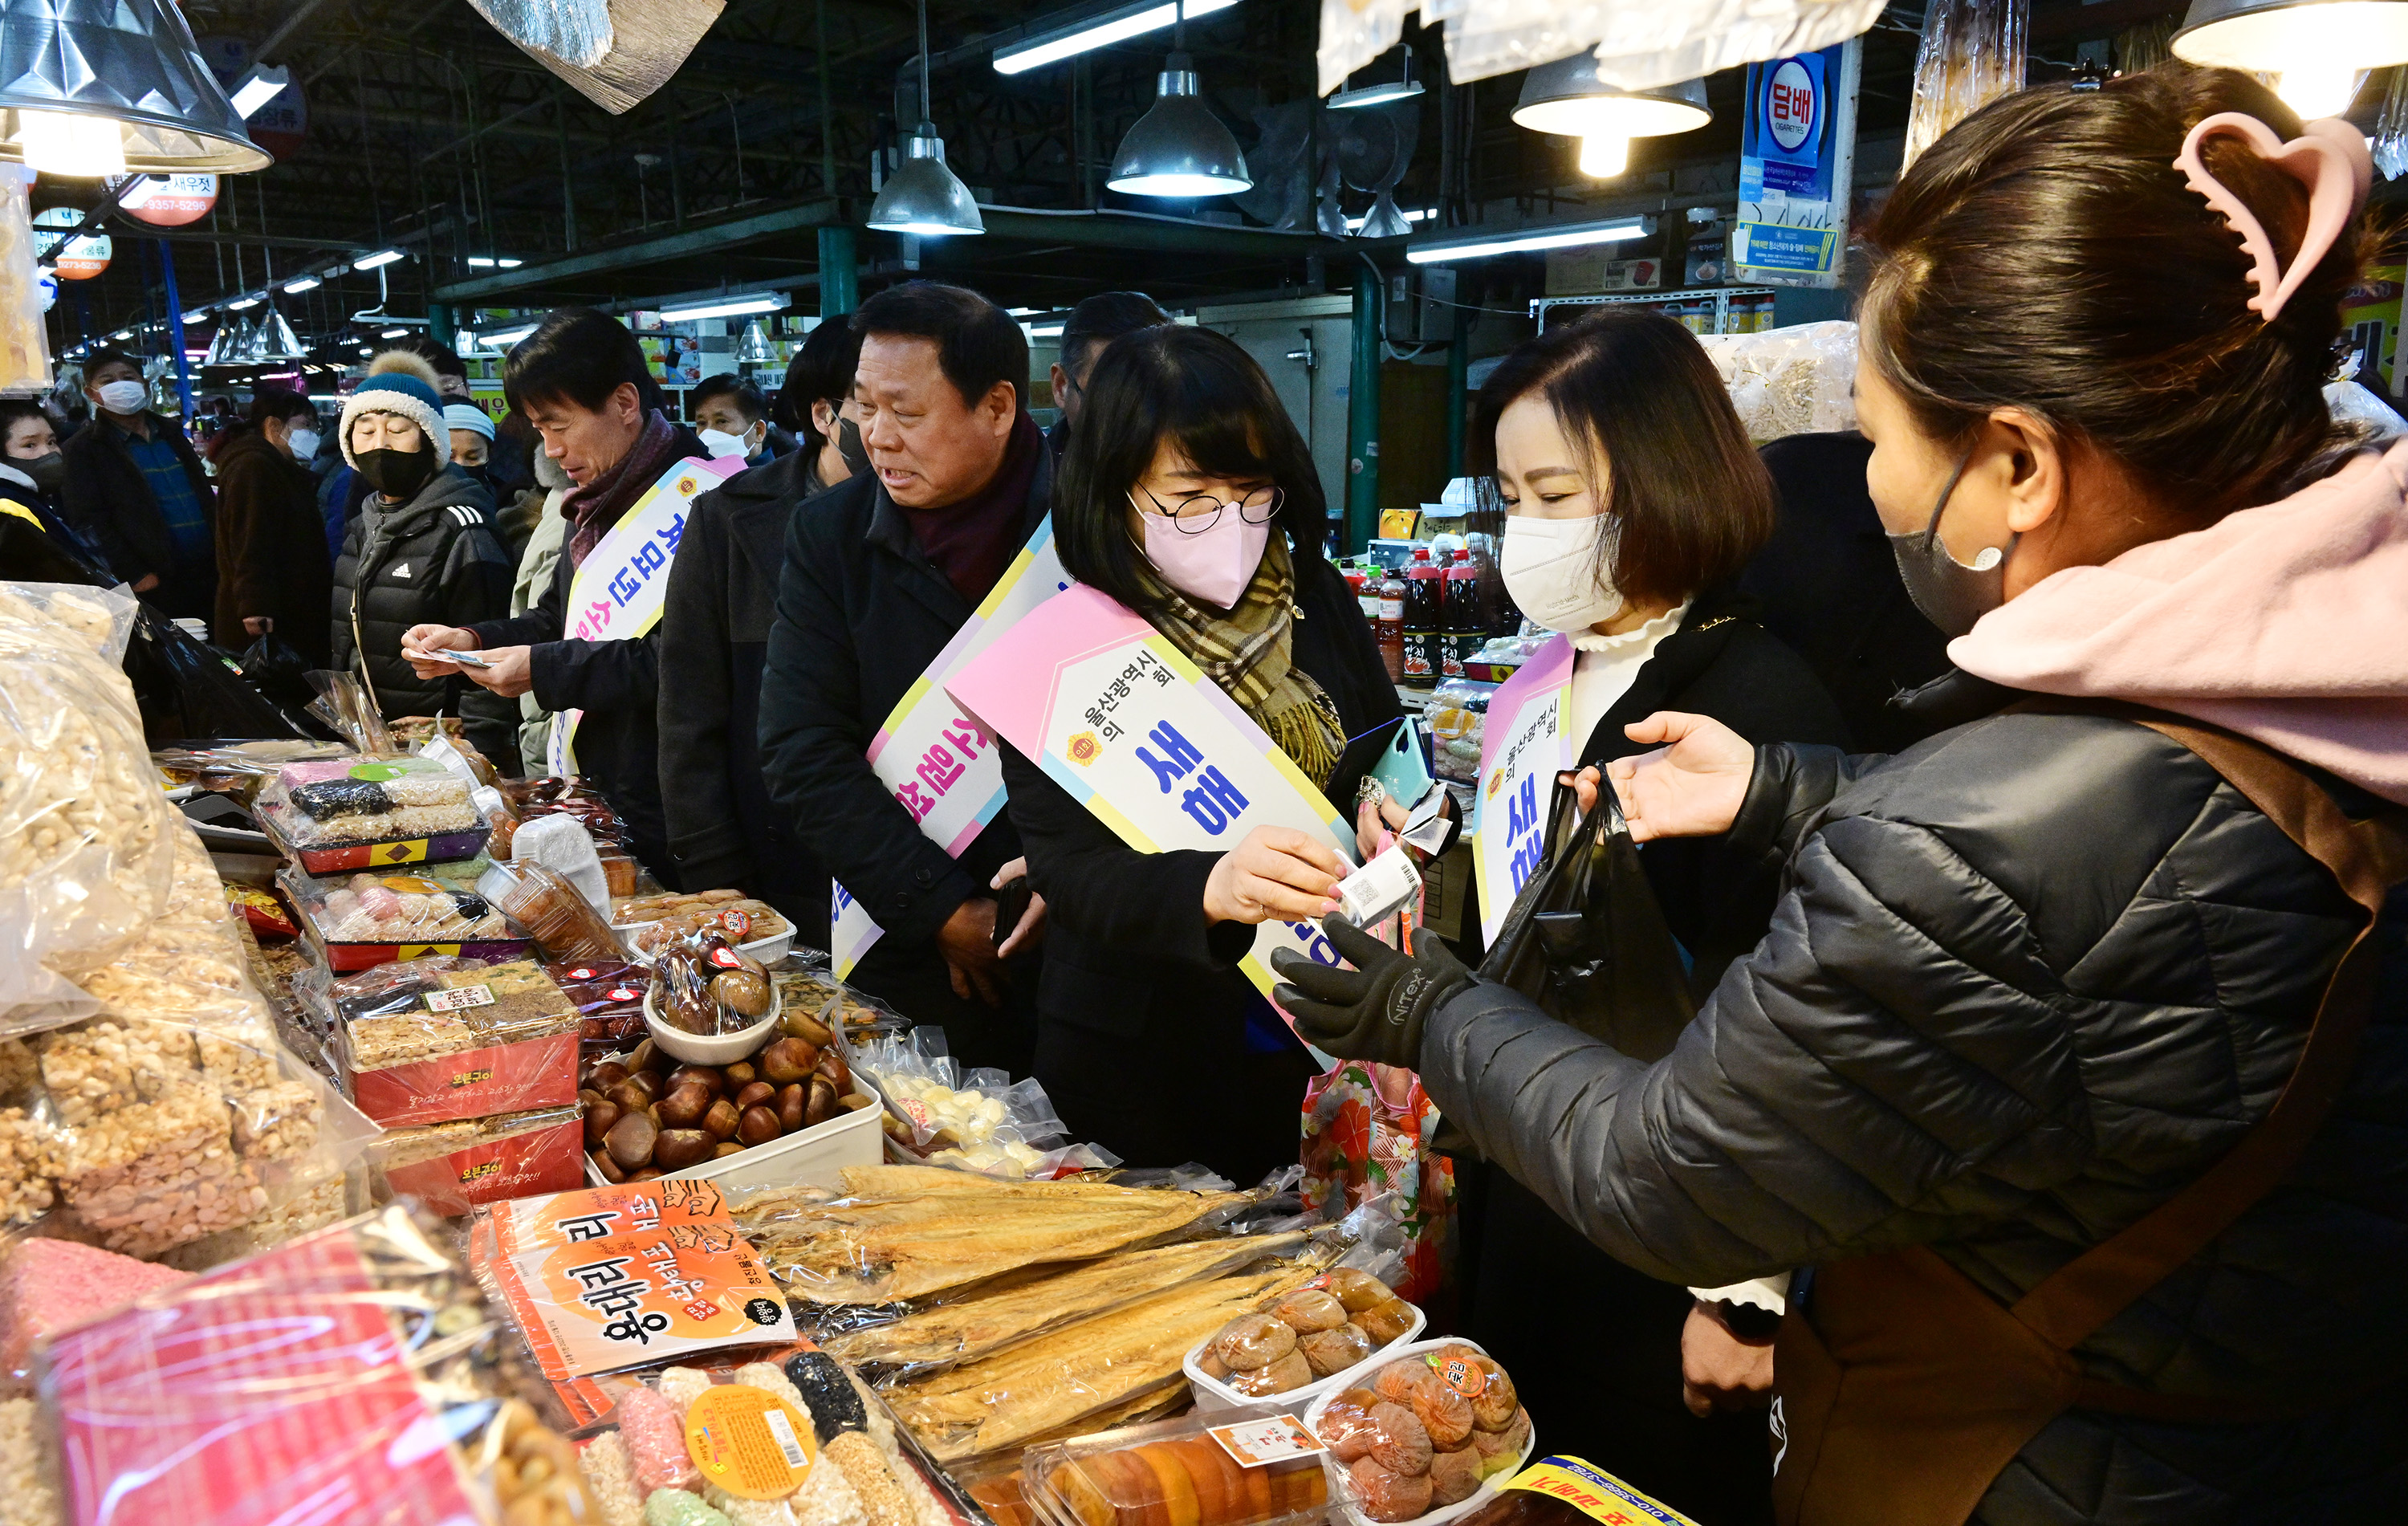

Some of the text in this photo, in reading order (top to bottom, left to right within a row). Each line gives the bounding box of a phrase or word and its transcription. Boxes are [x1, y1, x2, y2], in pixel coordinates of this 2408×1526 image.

[1772, 83, 1811, 124] 담배
[1084, 649, 1157, 727] 울산광역시
[1076, 739, 1092, 758] 의회
[1507, 698, 1558, 766] 울산광역시
[1134, 719, 1250, 836] 새해
[452, 1068, 494, 1087] 오븐구이
[462, 1163, 502, 1181] 오븐구이
[641, 1241, 705, 1302] 황태포
[734, 1253, 762, 1286] 청진물산
[567, 1257, 668, 1345] 용대리
[753, 1300, 777, 1324] 왕왕대
[1447, 1361, 1466, 1385] 곶감
[1528, 1476, 1606, 1509] 과메기
